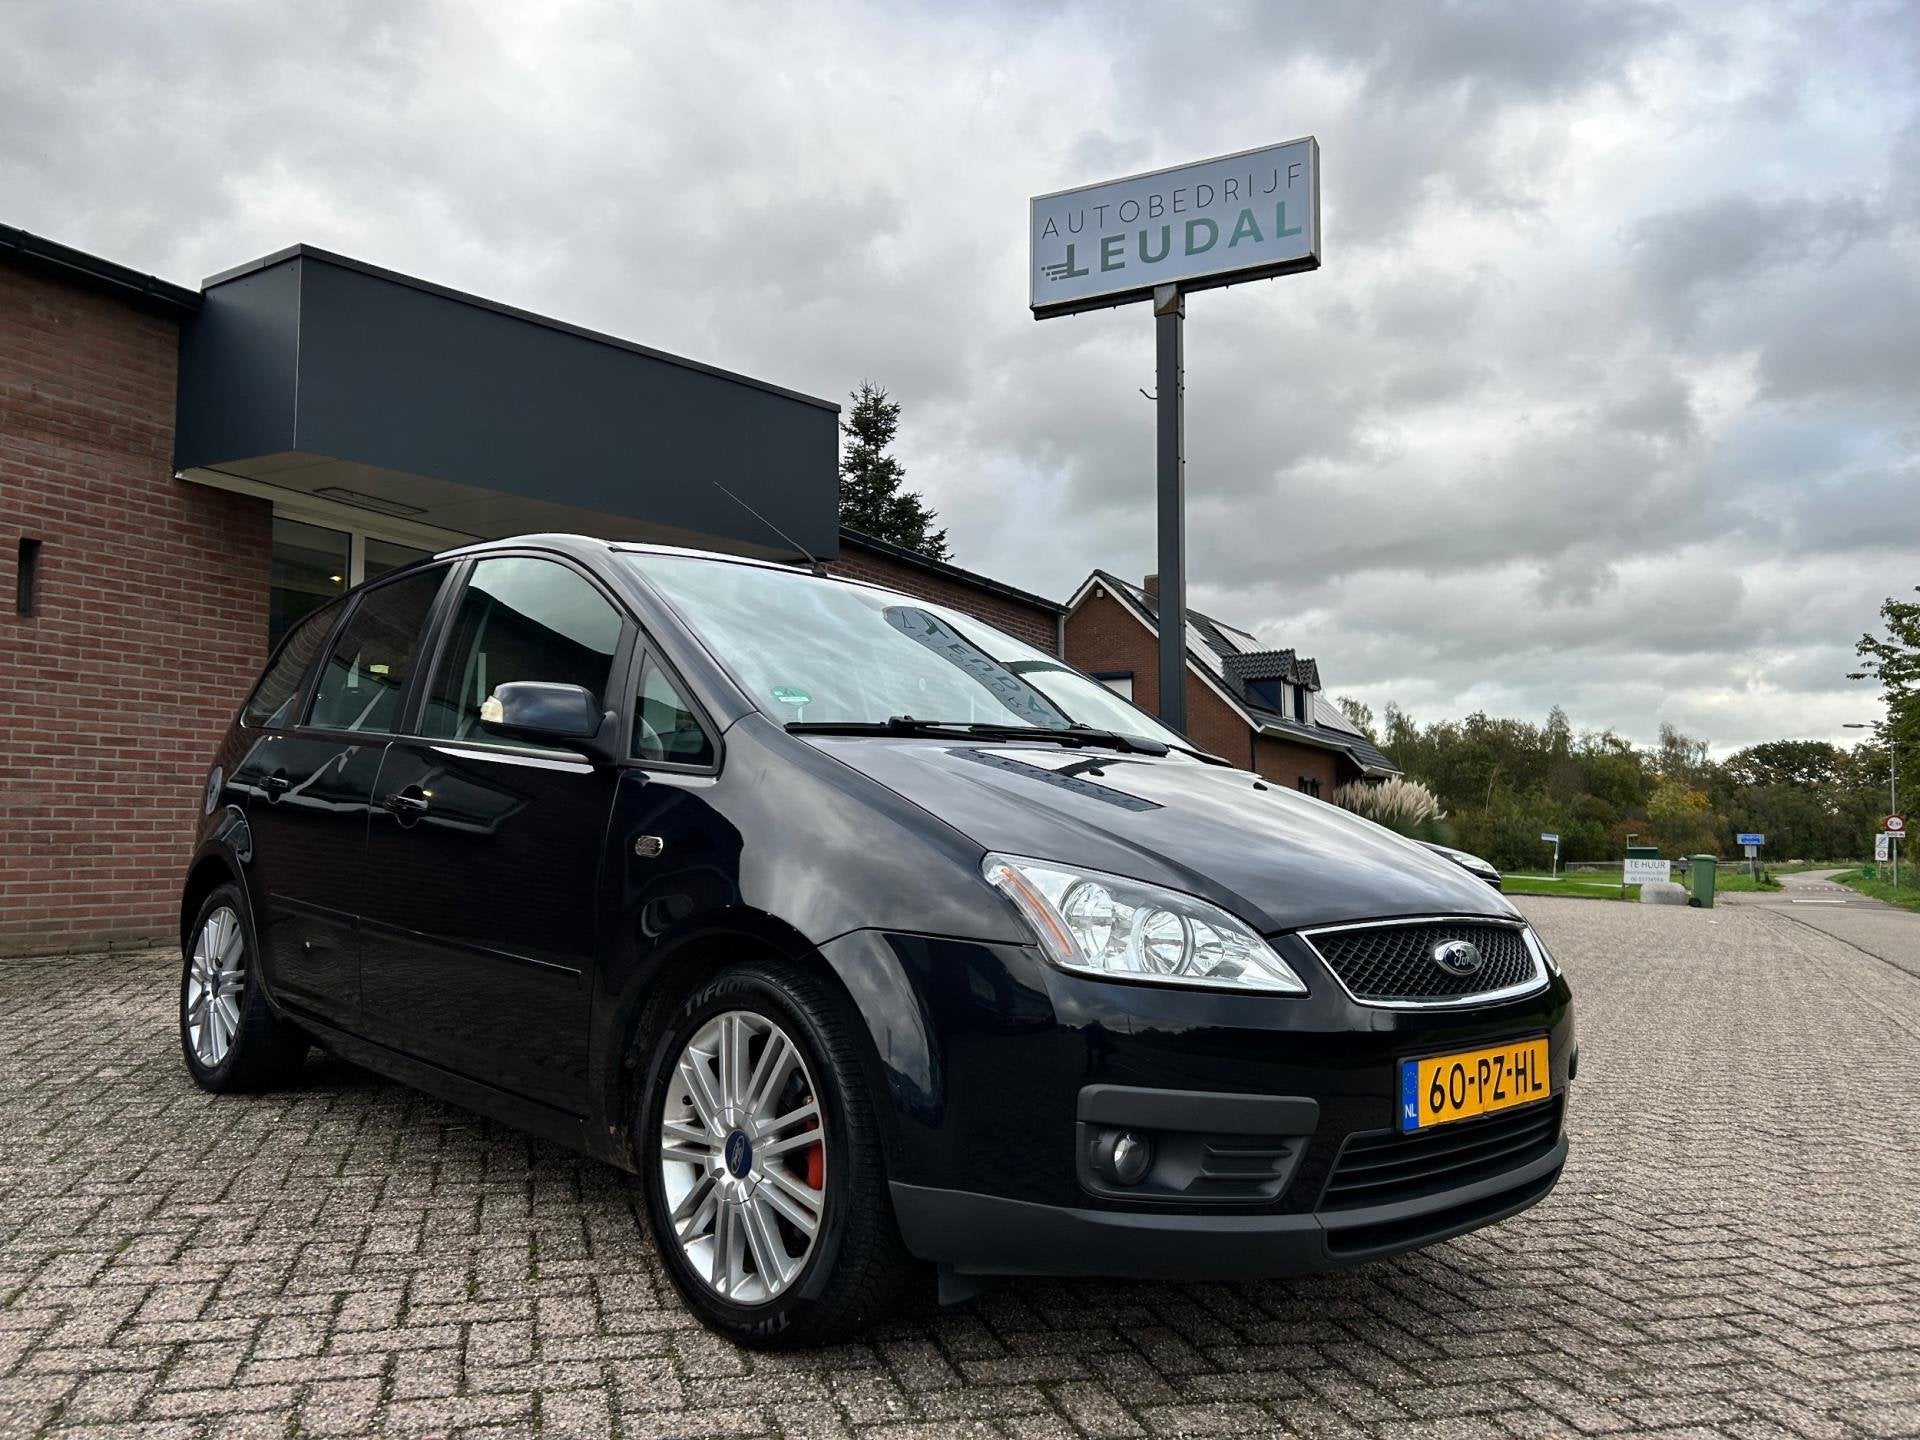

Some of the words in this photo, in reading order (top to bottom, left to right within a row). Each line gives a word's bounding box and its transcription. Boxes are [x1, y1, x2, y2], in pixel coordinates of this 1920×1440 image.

[1042, 163, 1302, 239] AUTOBEDRIJF
[1058, 201, 1302, 280] LEUDAL
[1630, 860, 1639, 869] TE
[1641, 860, 1666, 869] HUUR
[1404, 1103, 1417, 1118] NL
[1429, 1049, 1542, 1113] 60-PZ-HL
